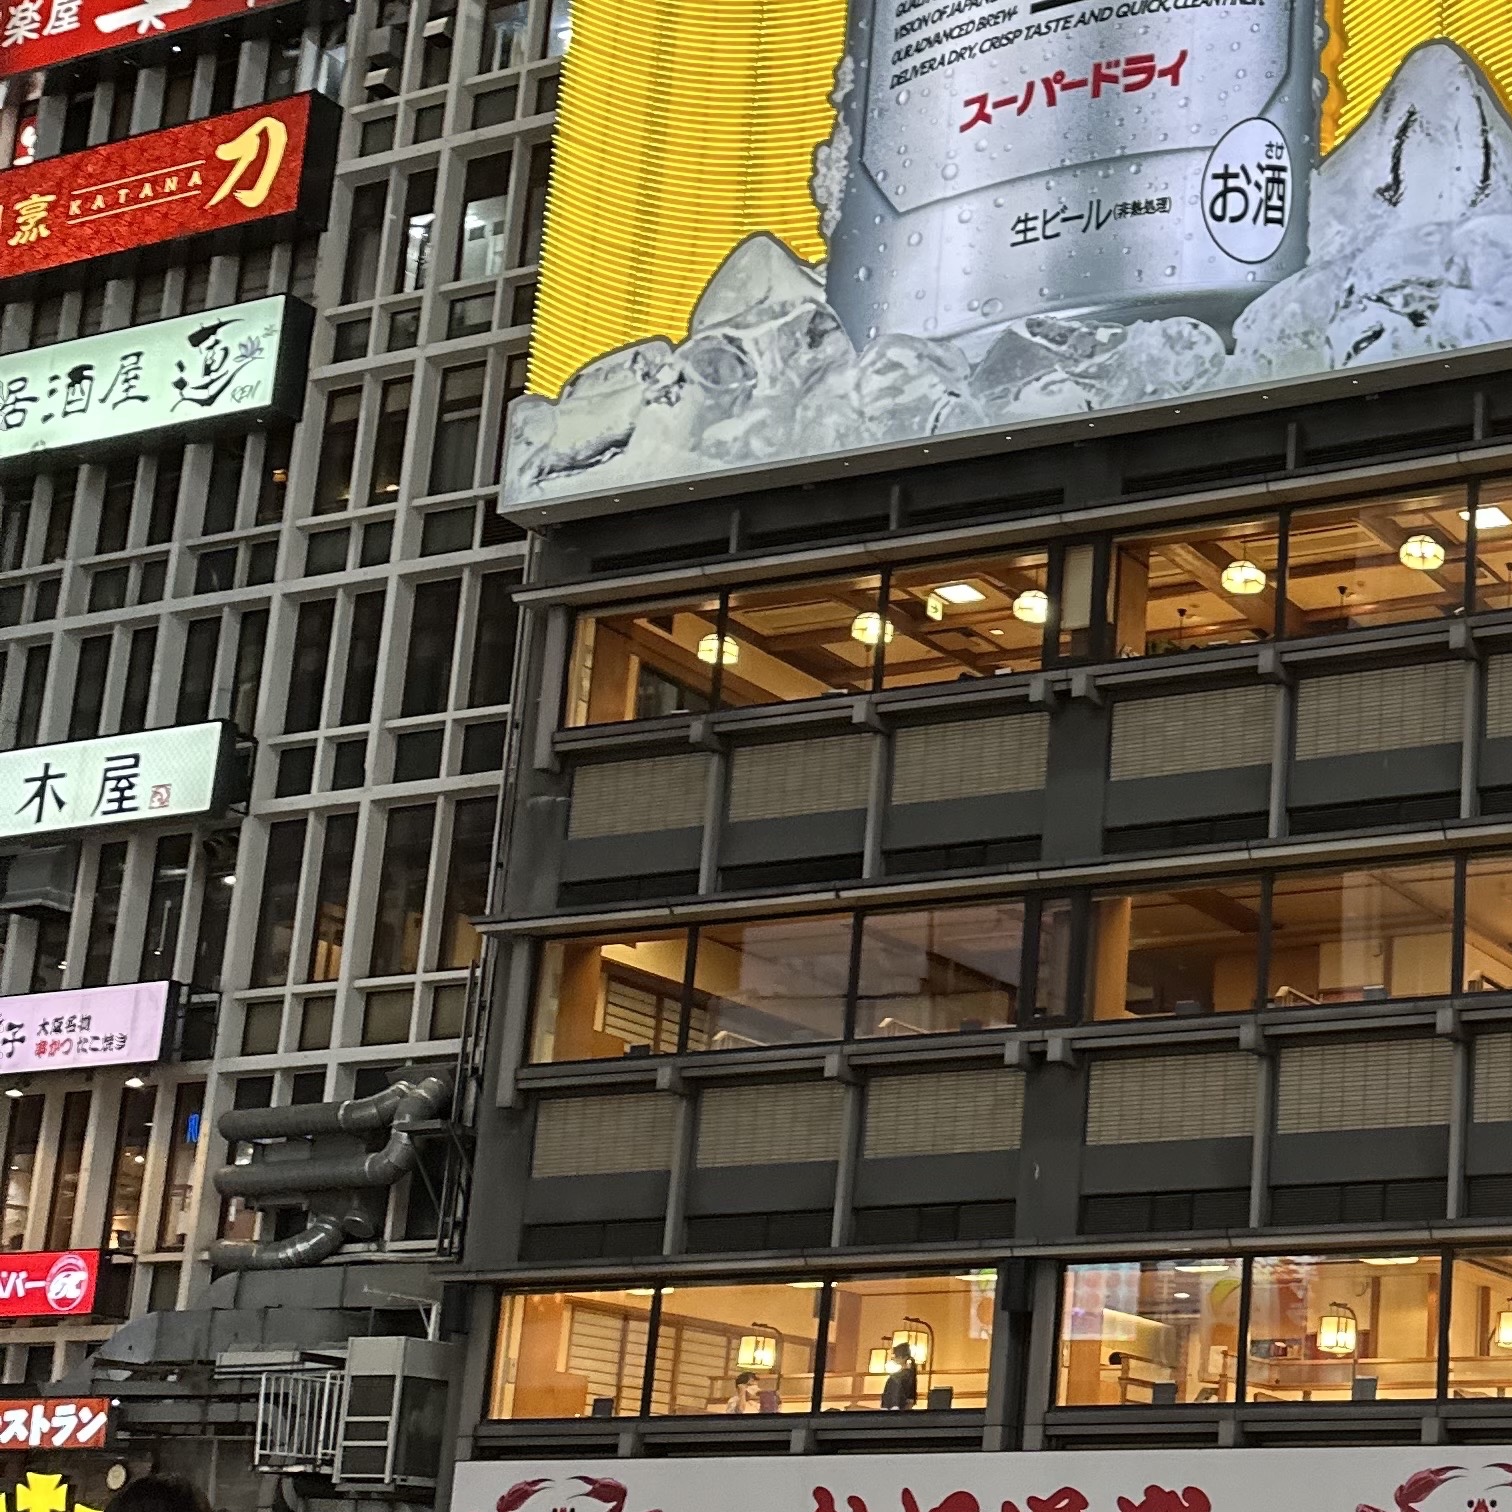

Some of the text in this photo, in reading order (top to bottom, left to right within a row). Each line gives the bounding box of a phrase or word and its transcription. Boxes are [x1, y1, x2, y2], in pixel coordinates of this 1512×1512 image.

[979, 28, 1023, 54] CRISP
[1024, 14, 1075, 40] TASTE
[1074, 6, 1113, 28] AND
[959, 49, 1188, 133] スーパードライ
[68, 170, 203, 216] KATANA
[204, 116, 288, 208] 刀
[1208, 161, 1288, 228] お酒
[14, 752, 141, 823] 木屋
